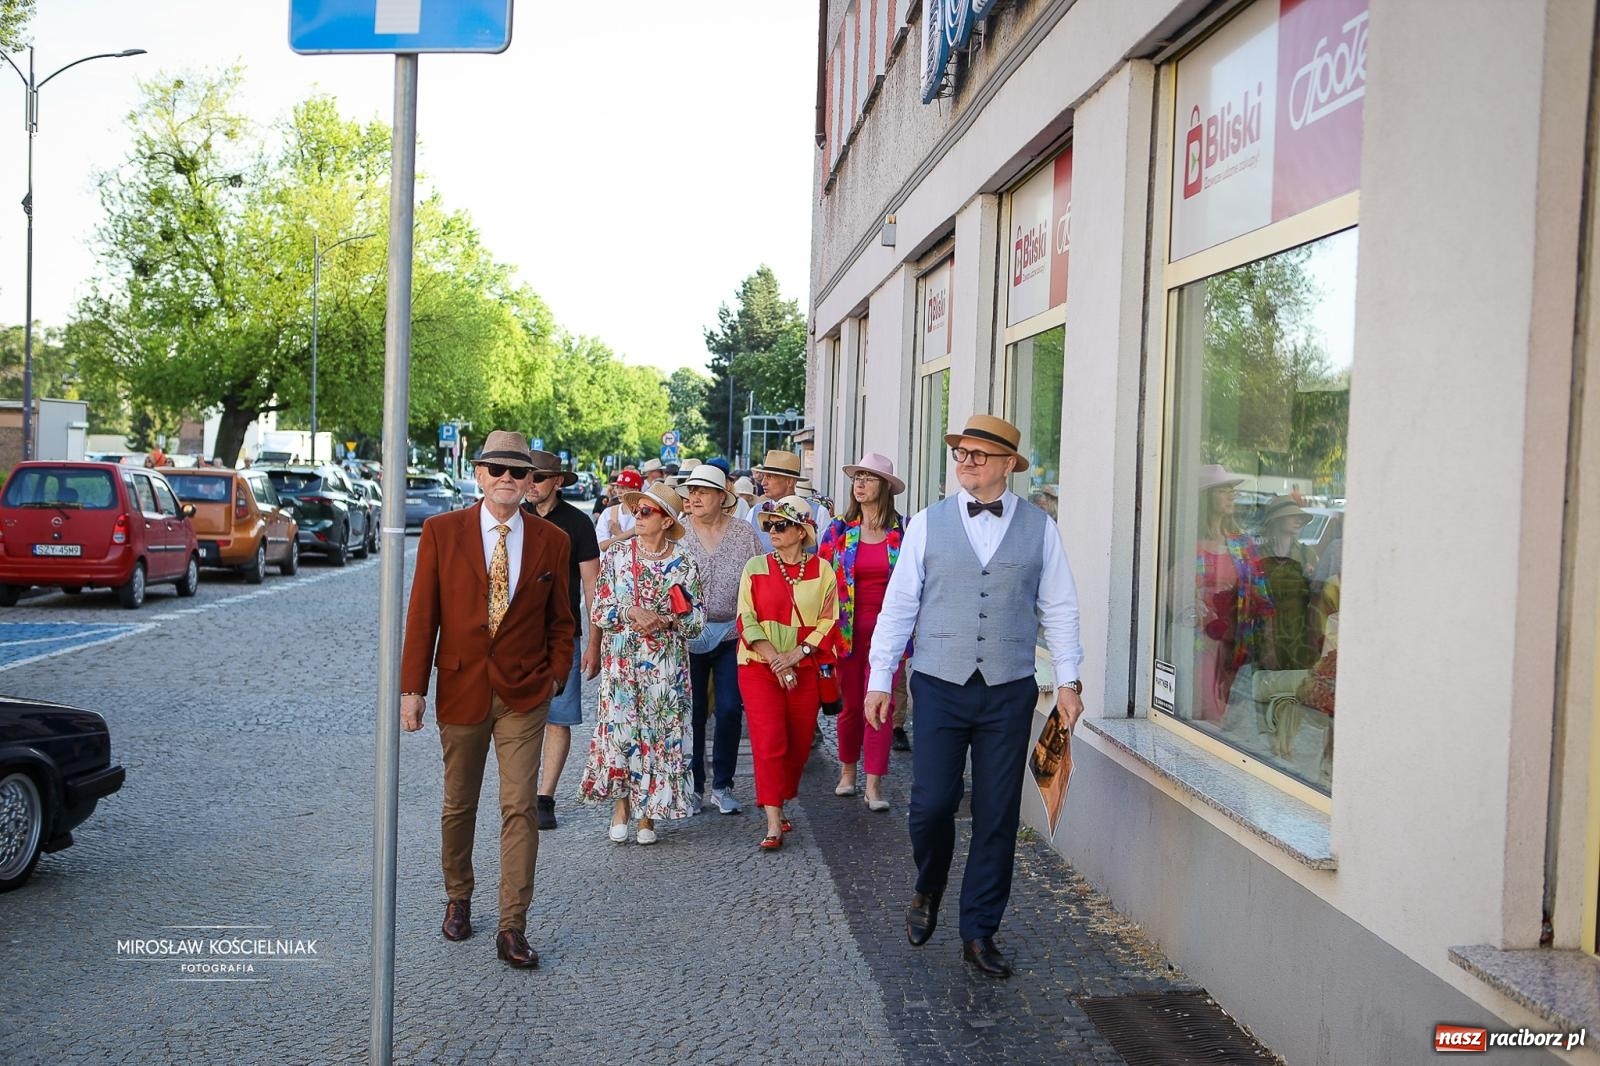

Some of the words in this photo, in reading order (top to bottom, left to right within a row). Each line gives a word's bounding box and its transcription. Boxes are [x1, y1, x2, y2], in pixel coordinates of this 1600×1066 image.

[1205, 81, 1262, 169] Bliski
[1023, 218, 1047, 269] Bliski
[443, 425, 453, 439] P
